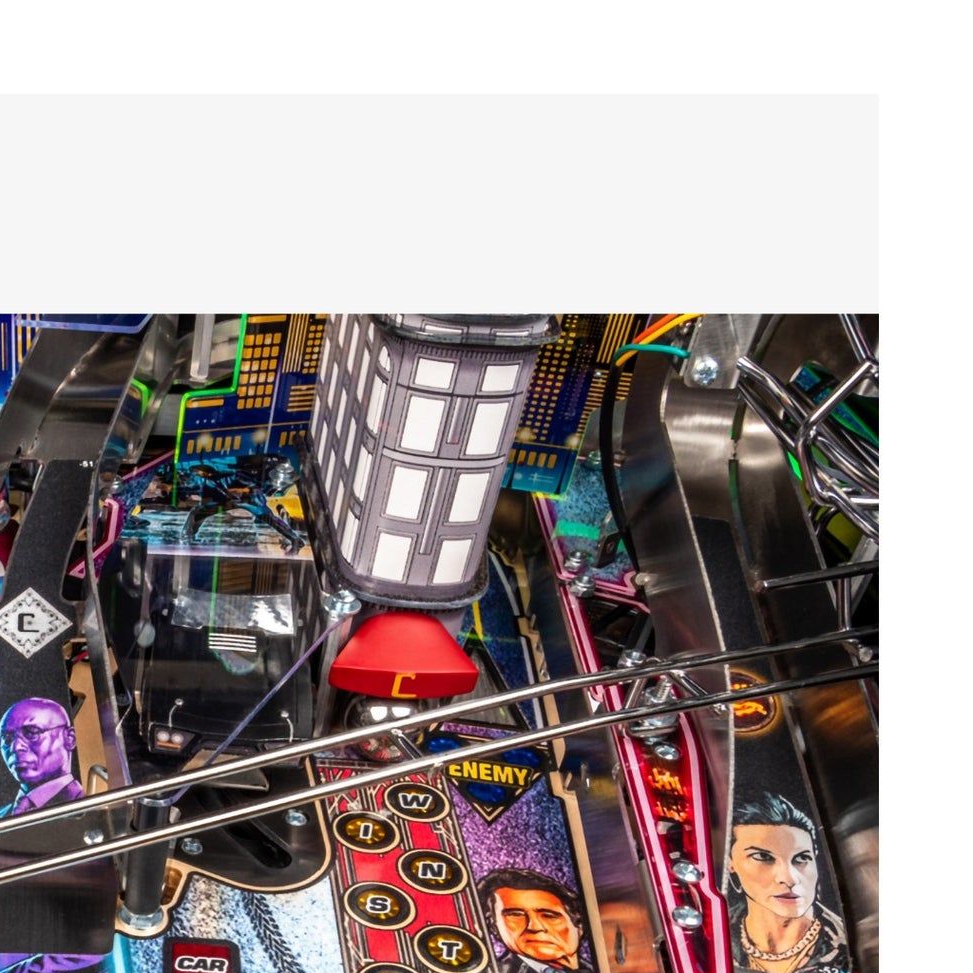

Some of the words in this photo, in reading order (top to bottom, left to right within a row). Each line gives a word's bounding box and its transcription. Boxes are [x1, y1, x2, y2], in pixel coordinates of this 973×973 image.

[391, 673, 418, 698] C
[448, 760, 528, 787] ENEMY
[176, 957, 227, 973] CAR
